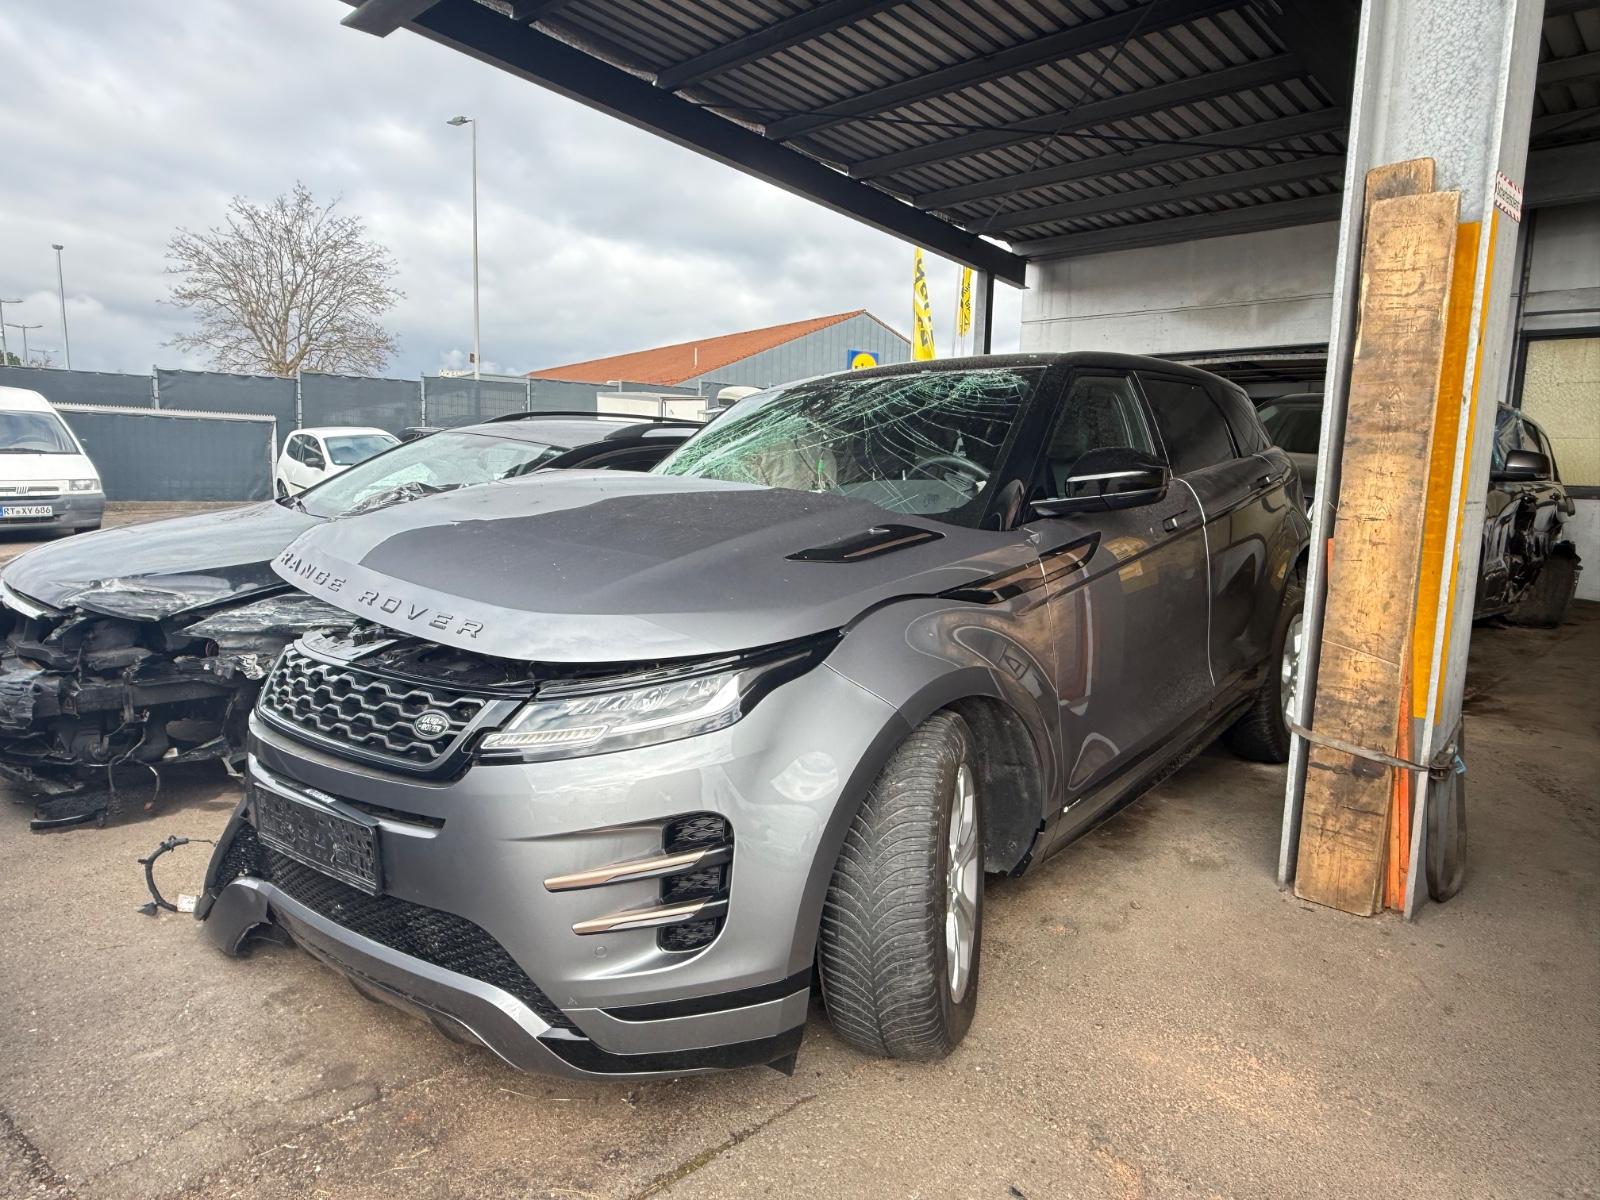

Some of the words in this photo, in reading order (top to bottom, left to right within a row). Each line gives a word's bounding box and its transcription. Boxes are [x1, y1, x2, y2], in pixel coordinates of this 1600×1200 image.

[3, 507, 15, 515] RT
[280, 552, 347, 592] RANGE
[358, 591, 484, 639] ROVER
